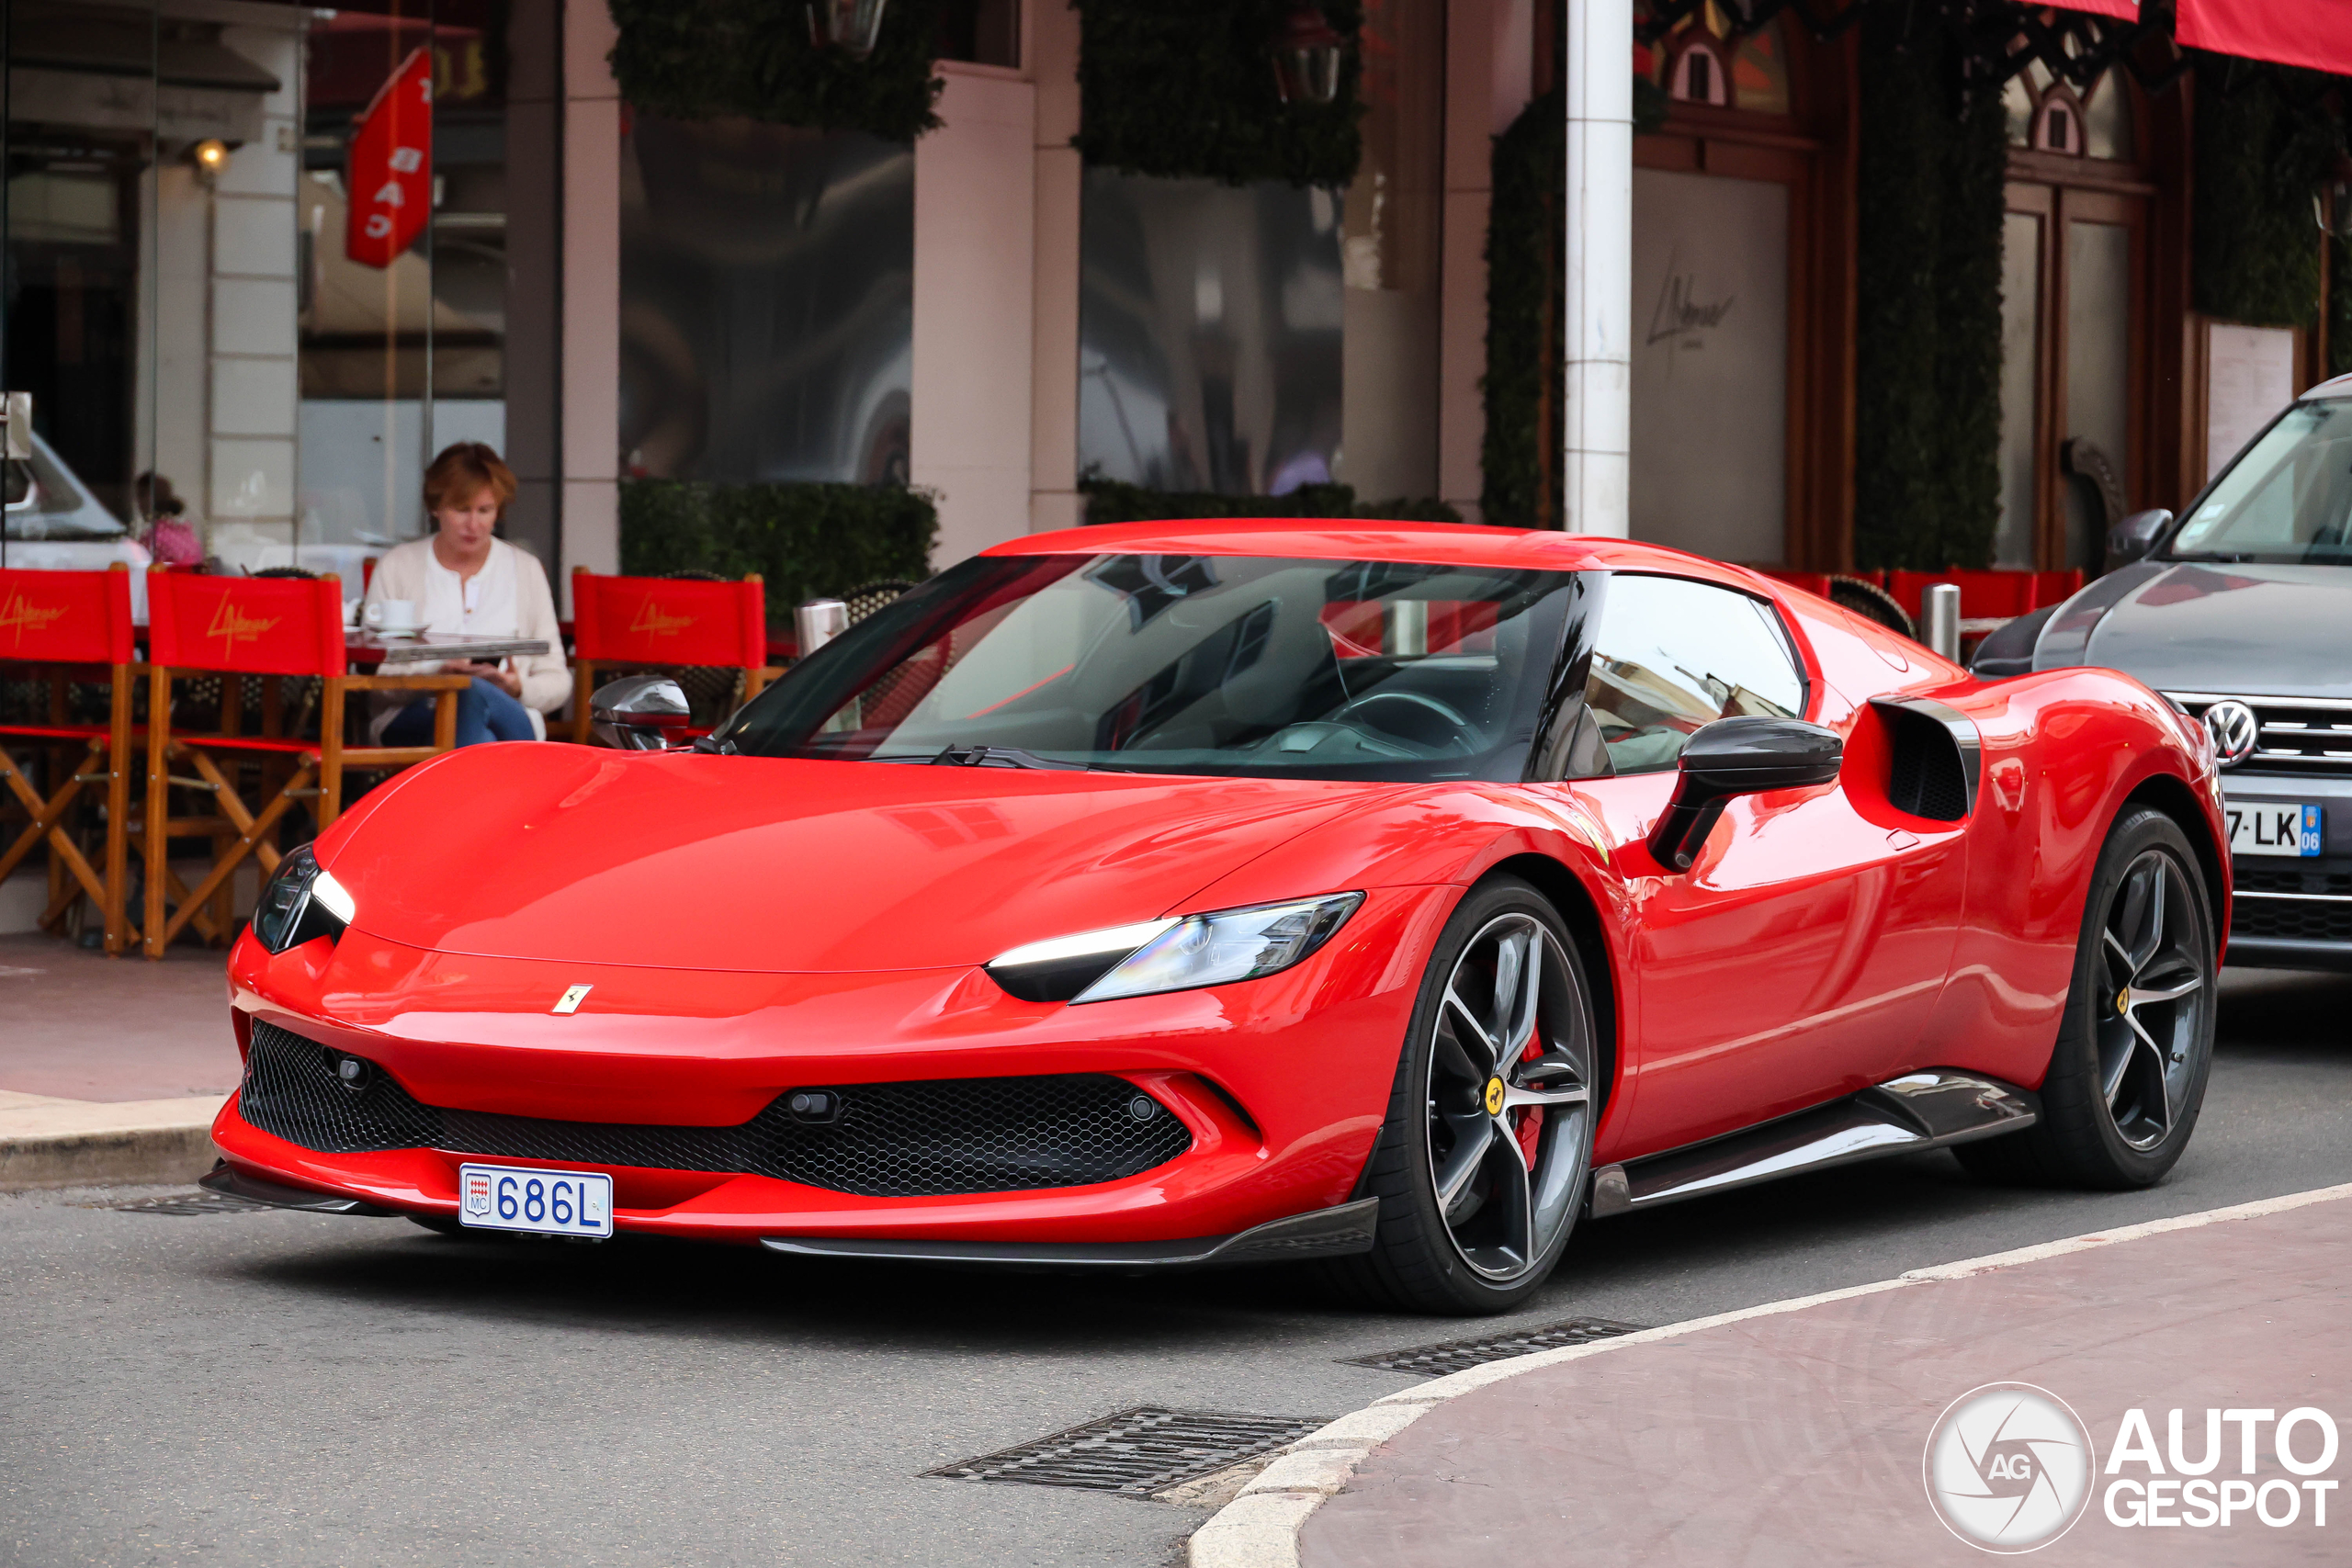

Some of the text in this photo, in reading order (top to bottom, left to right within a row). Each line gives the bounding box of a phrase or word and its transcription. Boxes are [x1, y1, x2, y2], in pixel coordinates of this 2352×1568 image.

[2301, 832, 2319, 850] 06
[470, 1177, 601, 1227] MC 686L
